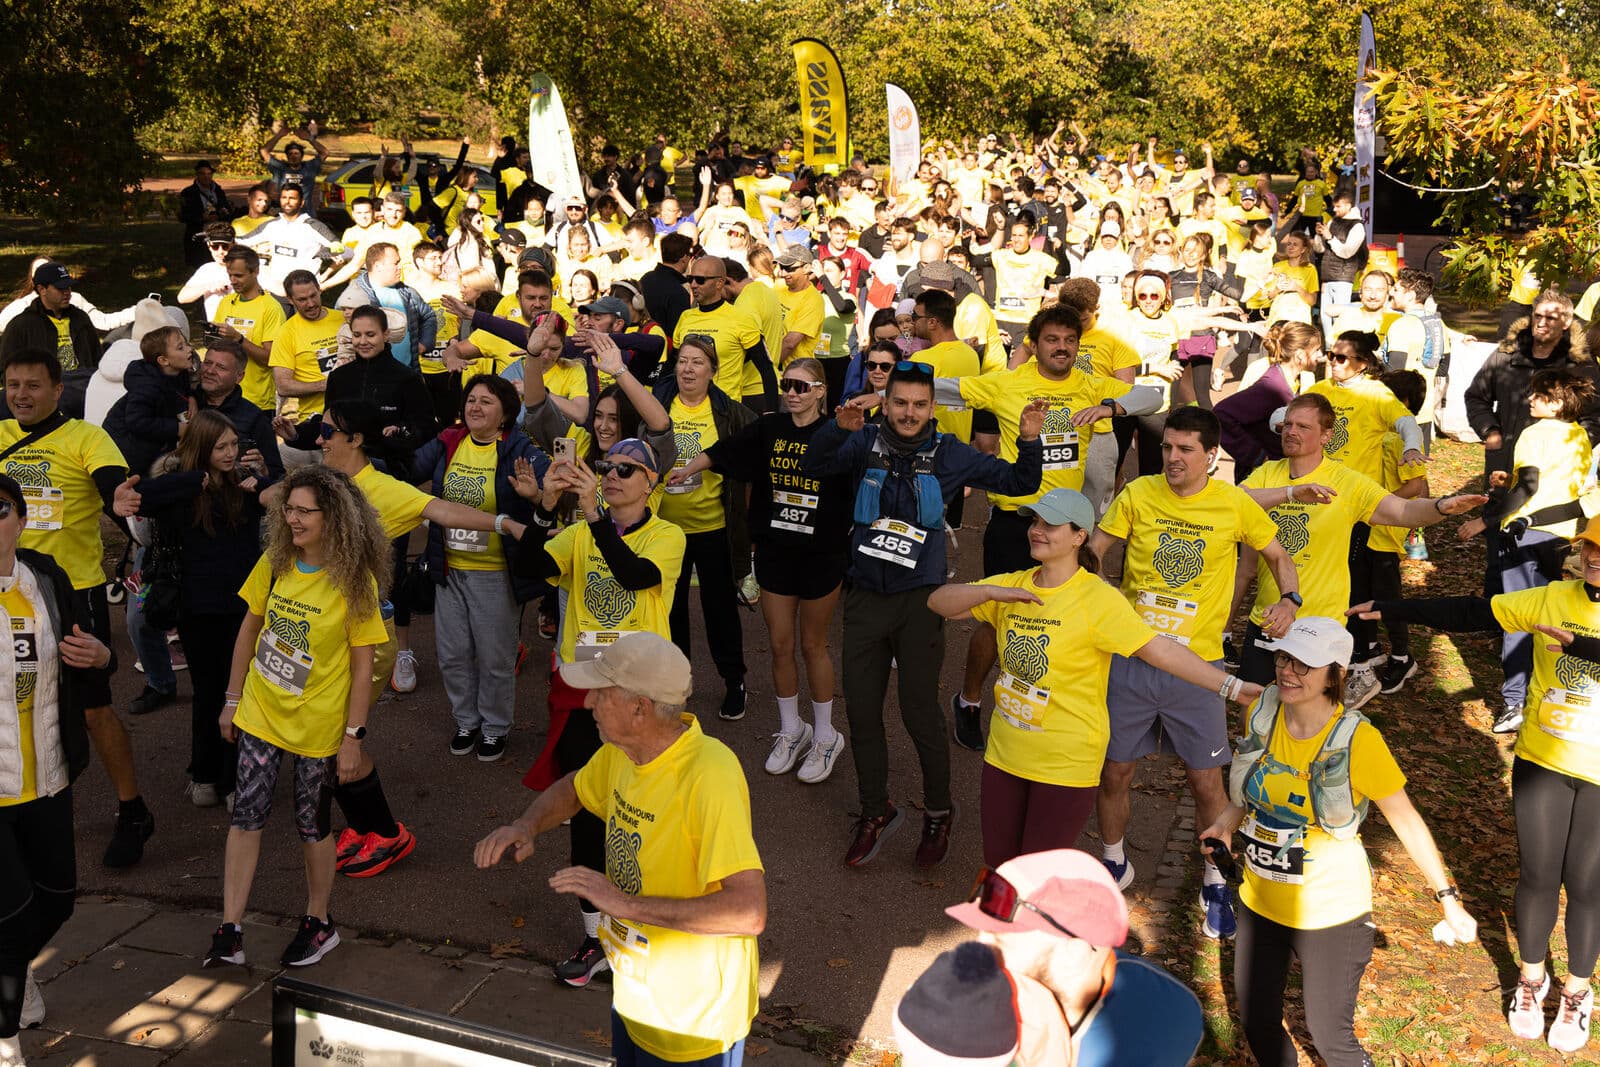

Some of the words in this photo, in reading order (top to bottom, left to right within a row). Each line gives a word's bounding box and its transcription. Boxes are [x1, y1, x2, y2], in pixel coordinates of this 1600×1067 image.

[780, 507, 809, 523] 487
[1155, 518, 1185, 528] FORTUNE
[1185, 521, 1214, 532] FAVOURS
[1166, 526, 1179, 534] THE
[1179, 529, 1201, 537] BRAVE
[449, 528, 480, 543] 104
[871, 534, 913, 555] 455
[587, 554, 609, 565] FORTU
[273, 602, 286, 612] THE
[286, 607, 307, 619] BRAVE
[293, 600, 322, 615] FAVOURS
[1013, 622, 1026, 631] THE
[1031, 617, 1062, 627] FAVOURS
[1143, 610, 1184, 632] 337
[1561, 621, 1589, 632] FORTUNE
[15, 639, 31, 658] 3
[264, 651, 296, 680] 138
[1000, 692, 1034, 721] 336
[621, 812, 640, 829] BRAVE
[626, 803, 655, 823] FAVOURS
[1246, 843, 1292, 870] 454
[337, 1045, 366, 1059] ROYAL
[336, 1055, 366, 1067] PARKS
